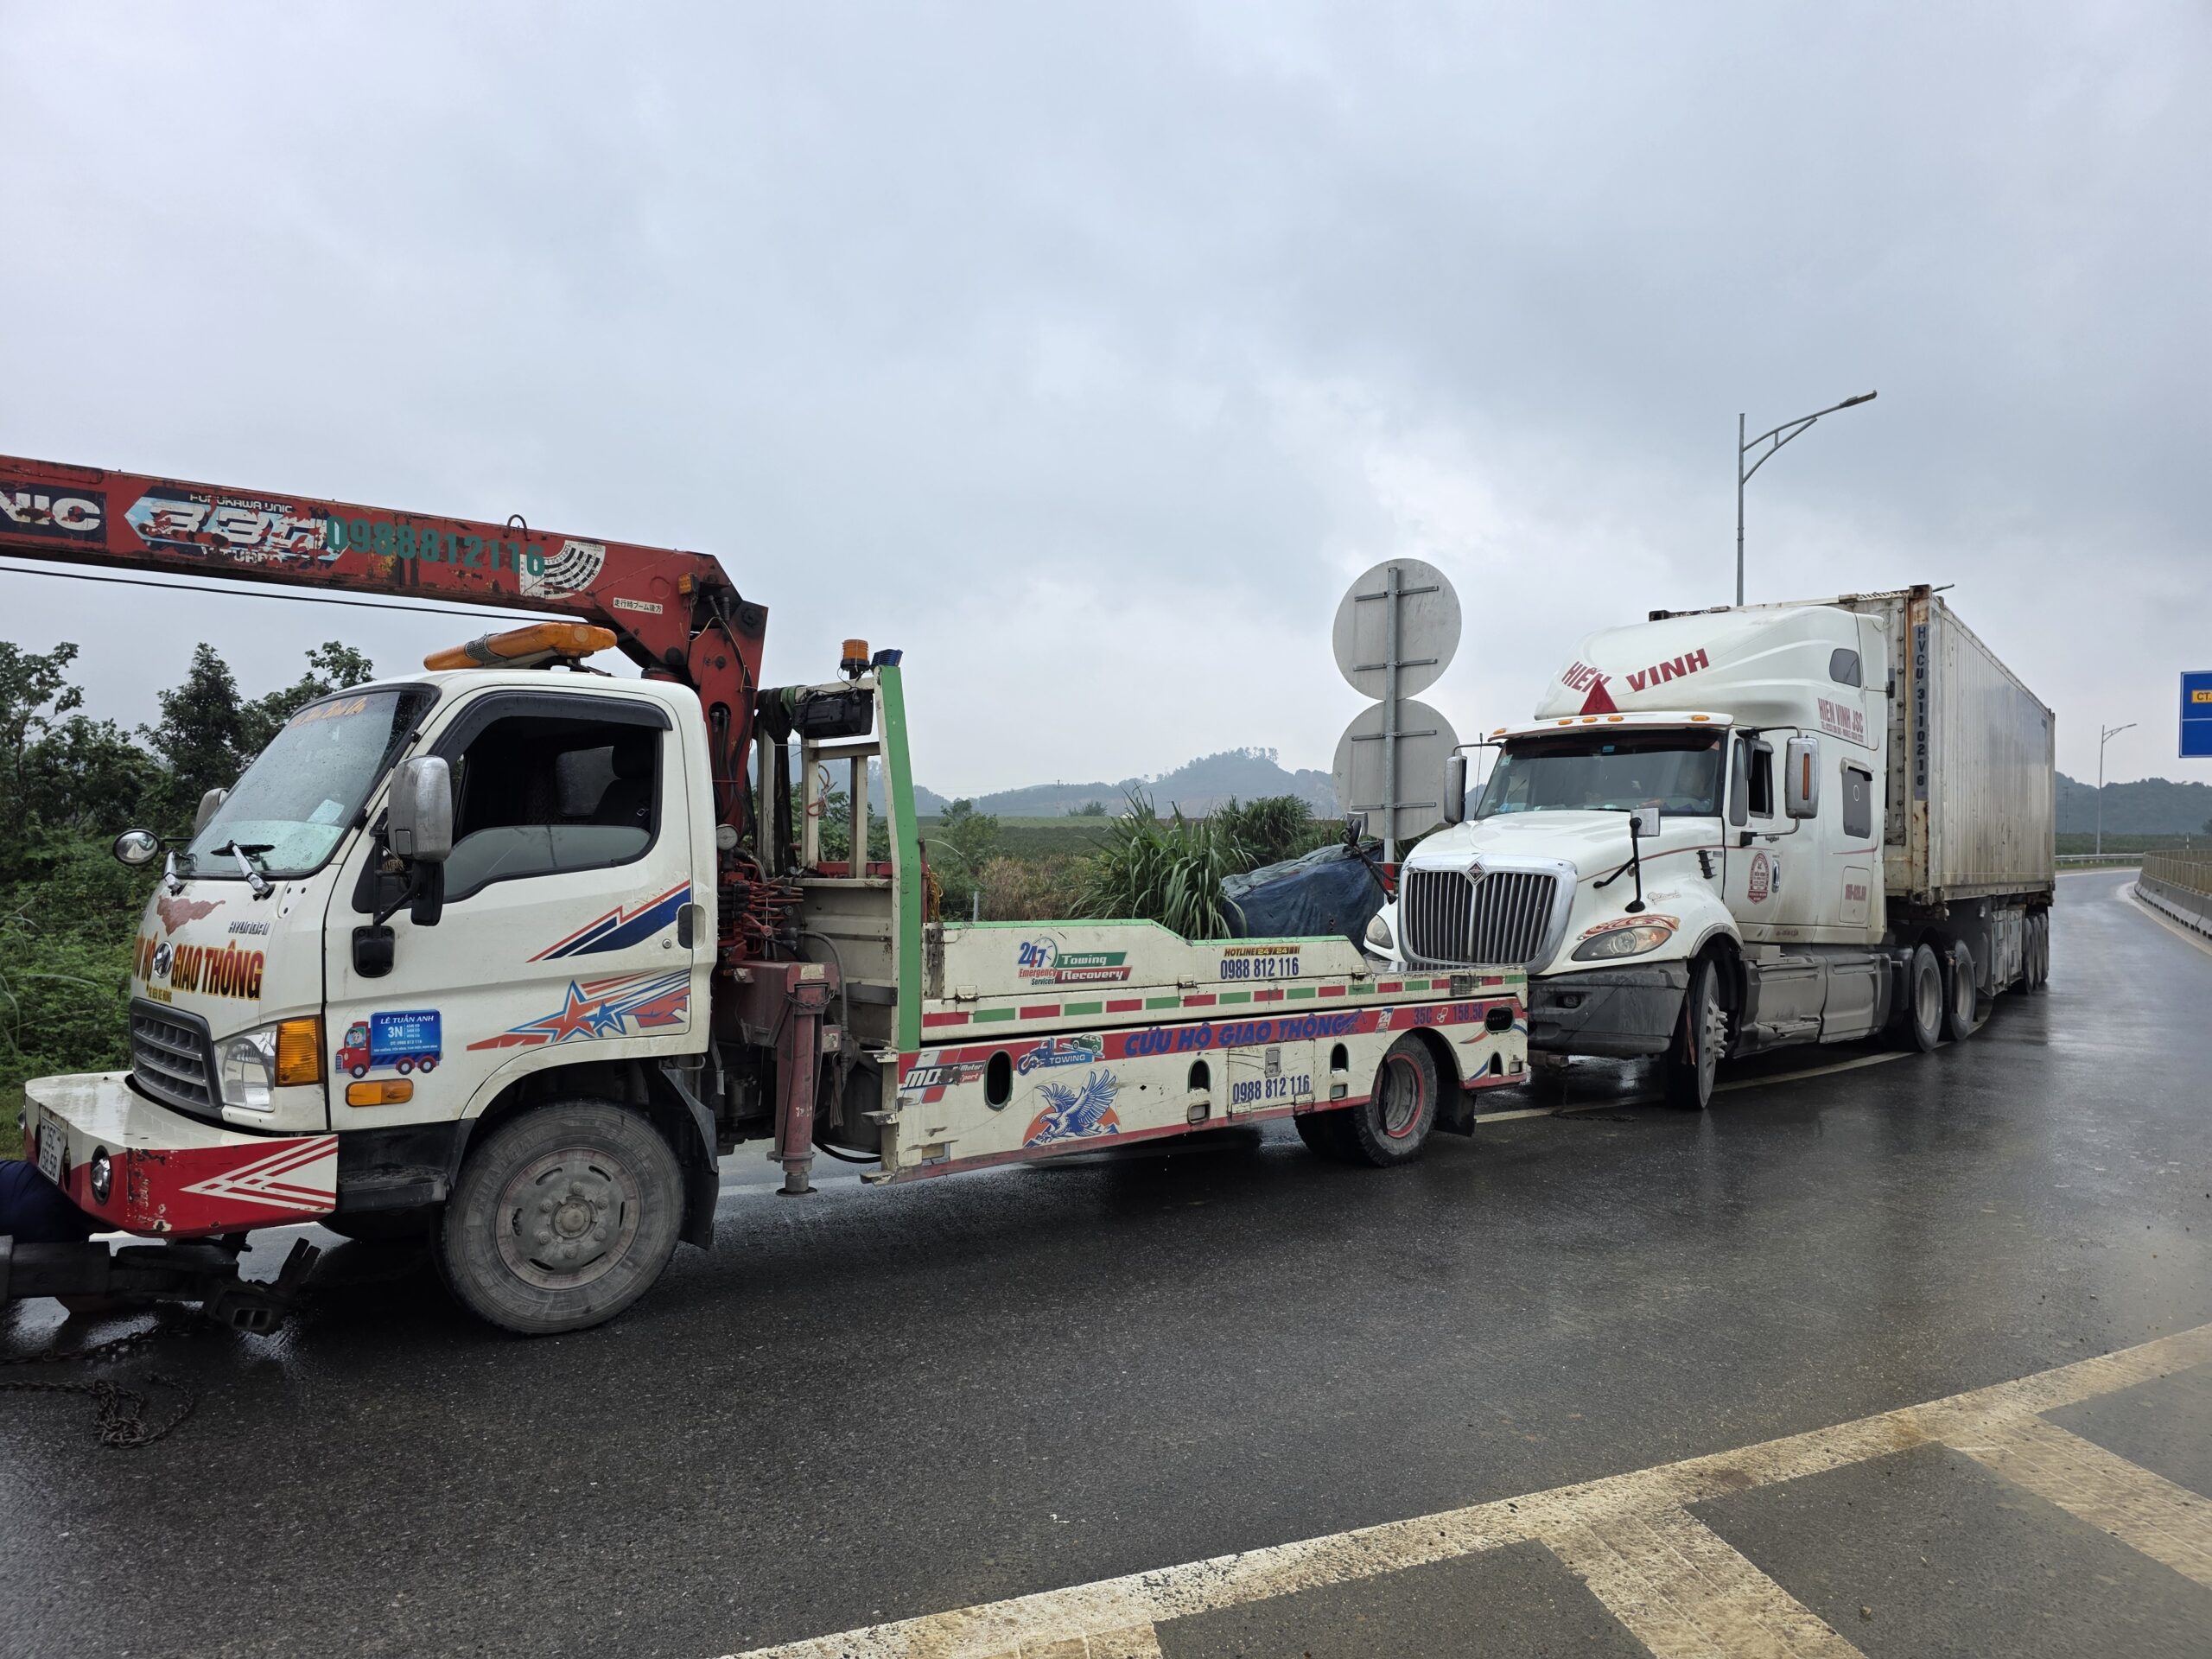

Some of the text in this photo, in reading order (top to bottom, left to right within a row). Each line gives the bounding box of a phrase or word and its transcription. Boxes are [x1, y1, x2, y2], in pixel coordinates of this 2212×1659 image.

[327, 516, 544, 576] 0988812116
[1916, 626, 1926, 679] HVCU
[1625, 648, 1709, 692] VINH
[228, 921, 270, 936] HYUNDAI
[1061, 954, 1107, 966] Towing
[1224, 947, 1255, 957] HOTLINE
[170, 943, 204, 993] GIAO
[200, 938, 264, 1001] THÔNG
[1019, 968, 1058, 978] Emergency
[1061, 969, 1124, 981] Recovery
[1220, 957, 1300, 980] 0988 812 116
[1414, 1007, 1433, 1025] 35C
[387, 1026, 403, 1038] 3N
[1125, 1013, 1346, 1056] CỨU HỘ GIAO THÔNG
[1049, 1054, 1086, 1064] TOWING
[961, 1073, 979, 1082] port
[1232, 1074, 1310, 1103] 0988 812 116
